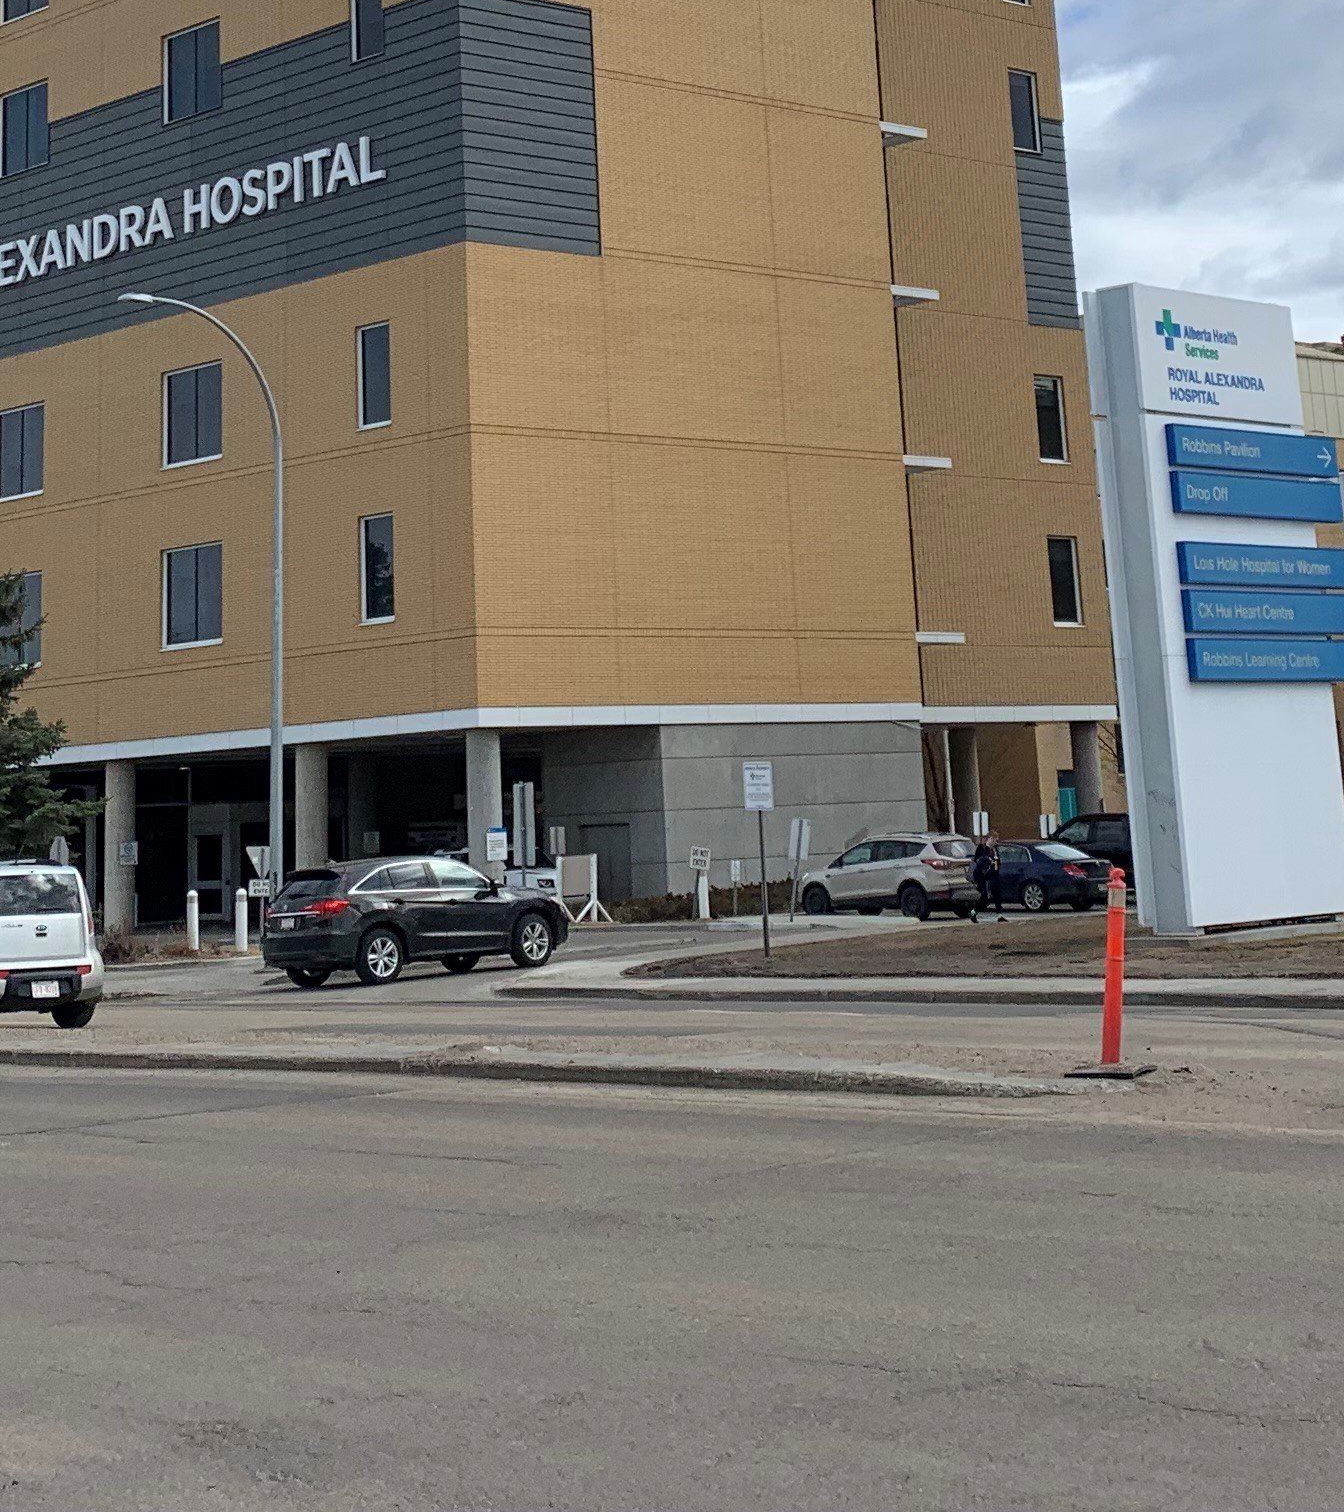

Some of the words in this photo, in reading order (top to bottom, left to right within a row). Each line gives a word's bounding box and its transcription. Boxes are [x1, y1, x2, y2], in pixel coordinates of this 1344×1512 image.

[182, 135, 387, 235] HOSPITAL
[1183, 325, 1212, 342] Alberta
[1213, 329, 1238, 346] Health
[1185, 343, 1219, 360] Services
[1167, 367, 1202, 385] ROYAL
[1205, 373, 1265, 392] ALEXANDRA
[1169, 387, 1220, 406] HOSPITAL
[1182, 437, 1222, 455] Robbins
[1224, 442, 1261, 459] Pavilion
[1186, 484, 1211, 502] Drop
[1212, 486, 1229, 502] Off
[1193, 555, 1215, 571] Lois
[1217, 556, 1239, 572] Hole
[1241, 557, 1280, 576] Hospital
[1282, 559, 1295, 574] for
[1297, 560, 1331, 576] Women
[1235, 604, 1261, 620] Heart
[1263, 605, 1295, 621] Centre
[1202, 651, 1243, 668] Robbins
[1245, 653, 1287, 671] Learning
[1288, 653, 1321, 669] Centre
